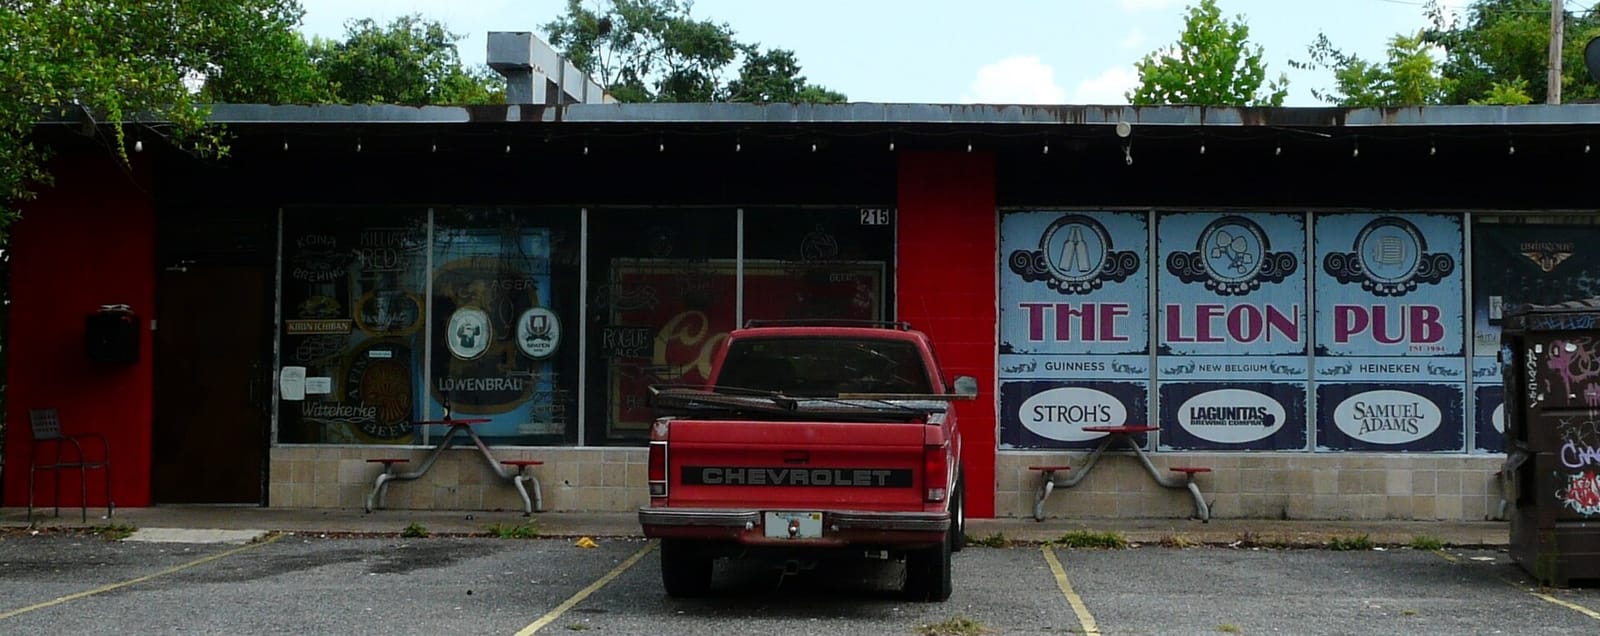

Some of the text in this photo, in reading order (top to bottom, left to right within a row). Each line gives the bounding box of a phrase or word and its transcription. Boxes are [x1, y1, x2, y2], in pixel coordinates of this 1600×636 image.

[862, 209, 888, 225] 215
[287, 321, 349, 331] KIRIN ICHIBAN
[1019, 302, 1445, 344] THE LEON PUB
[601, 327, 649, 350] ROGUE
[1044, 361, 1106, 372] GUINNESS
[1198, 364, 1268, 373] NEW BELGIUM
[1359, 364, 1420, 374] HEINEKEN
[1032, 404, 1111, 424] STROH'S
[1190, 406, 1267, 421] LAGUNITAS
[1352, 401, 1425, 421] SAMUEL
[1358, 417, 1420, 436] ADAMS
[701, 467, 893, 487] CHEVROLET
